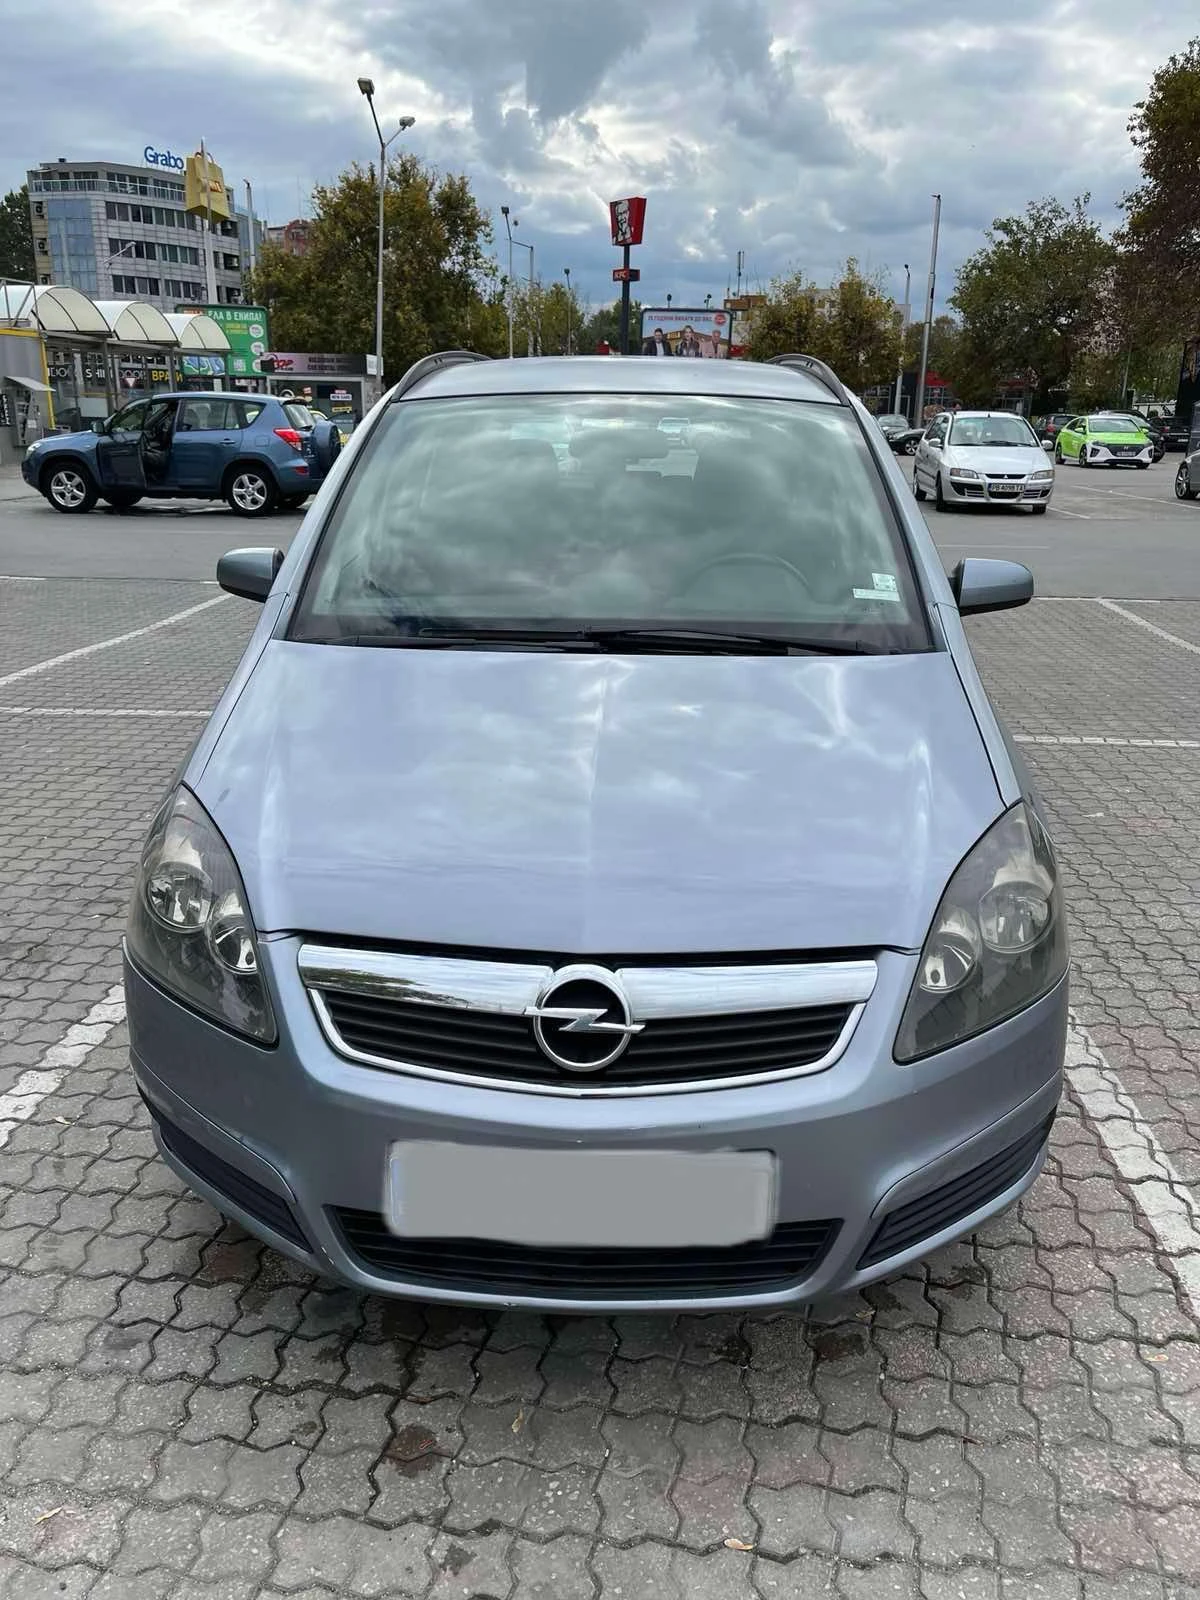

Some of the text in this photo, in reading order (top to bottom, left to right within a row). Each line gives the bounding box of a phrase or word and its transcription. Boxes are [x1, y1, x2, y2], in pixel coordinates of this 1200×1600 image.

[144, 146, 184, 170] Grabo
[614, 271, 626, 279] KFC
[226, 311, 232, 321] В
[151, 370, 183, 383] ВРАИ
